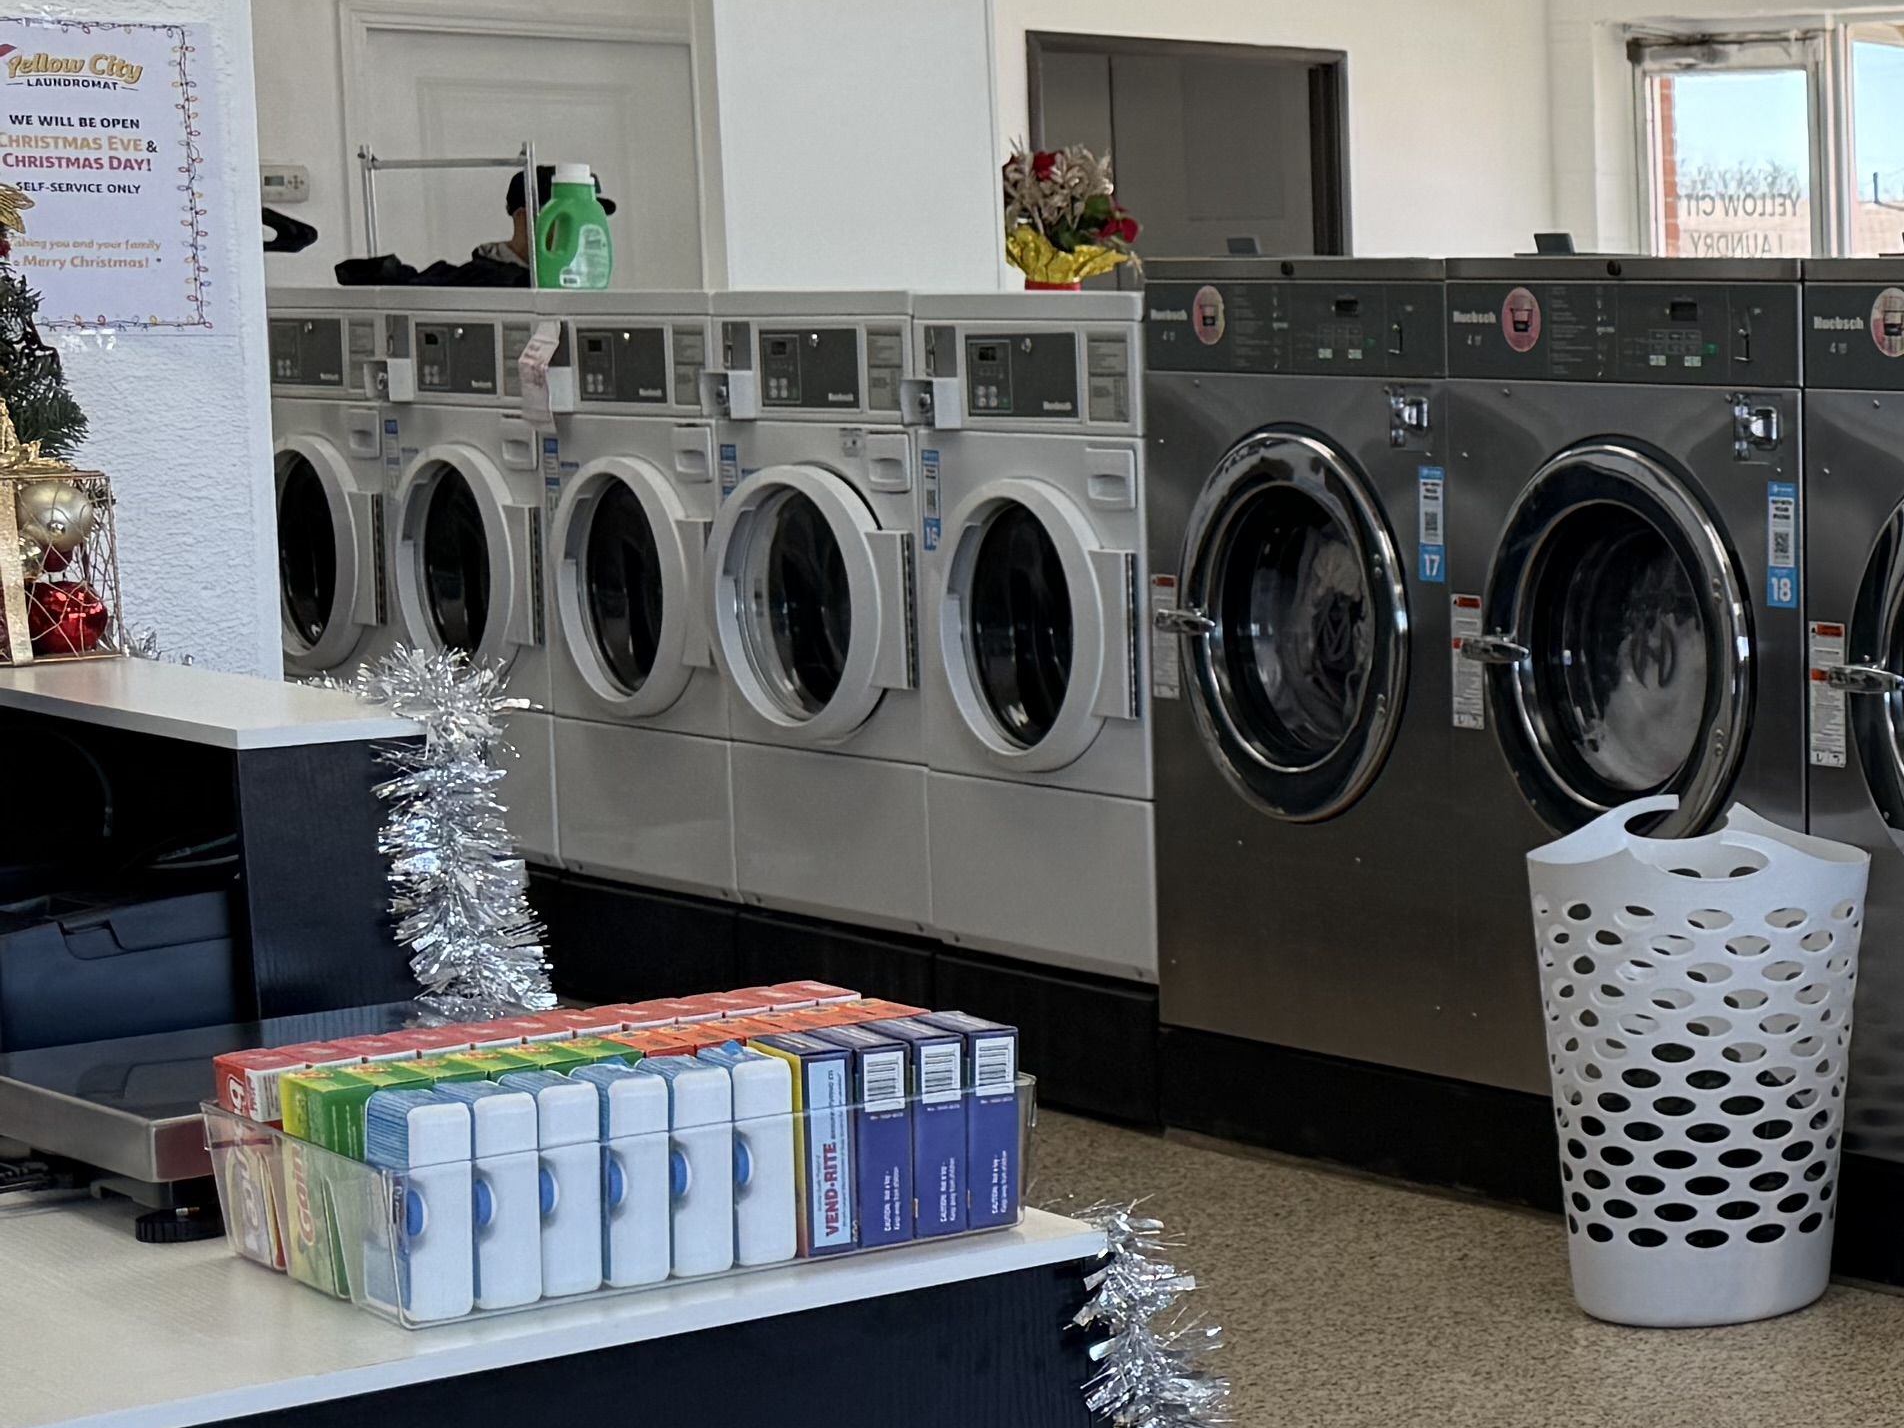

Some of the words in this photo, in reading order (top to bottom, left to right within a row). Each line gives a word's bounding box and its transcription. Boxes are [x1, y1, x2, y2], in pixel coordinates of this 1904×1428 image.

[6, 53, 85, 78] Yellow
[90, 54, 143, 84] City
[27, 79, 118, 90] LAUNDROMAT
[9, 114, 33, 125] WE
[38, 115, 74, 127] WILL
[79, 117, 96, 128] BE
[100, 118, 140, 129] OPEN
[108, 136, 143, 152] EVE
[146, 140, 158, 153] &
[2, 153, 104, 170] CHRISTMAS
[108, 156, 152, 172] DAY!
[16, 181, 103, 194] SELF-SERVICE
[107, 183, 141, 195] ONLY
[23, 255, 66, 270] Merry
[70, 255, 149, 269] Christmas!
[1423, 554, 1440, 578] 17
[1771, 576, 1792, 604] 18
